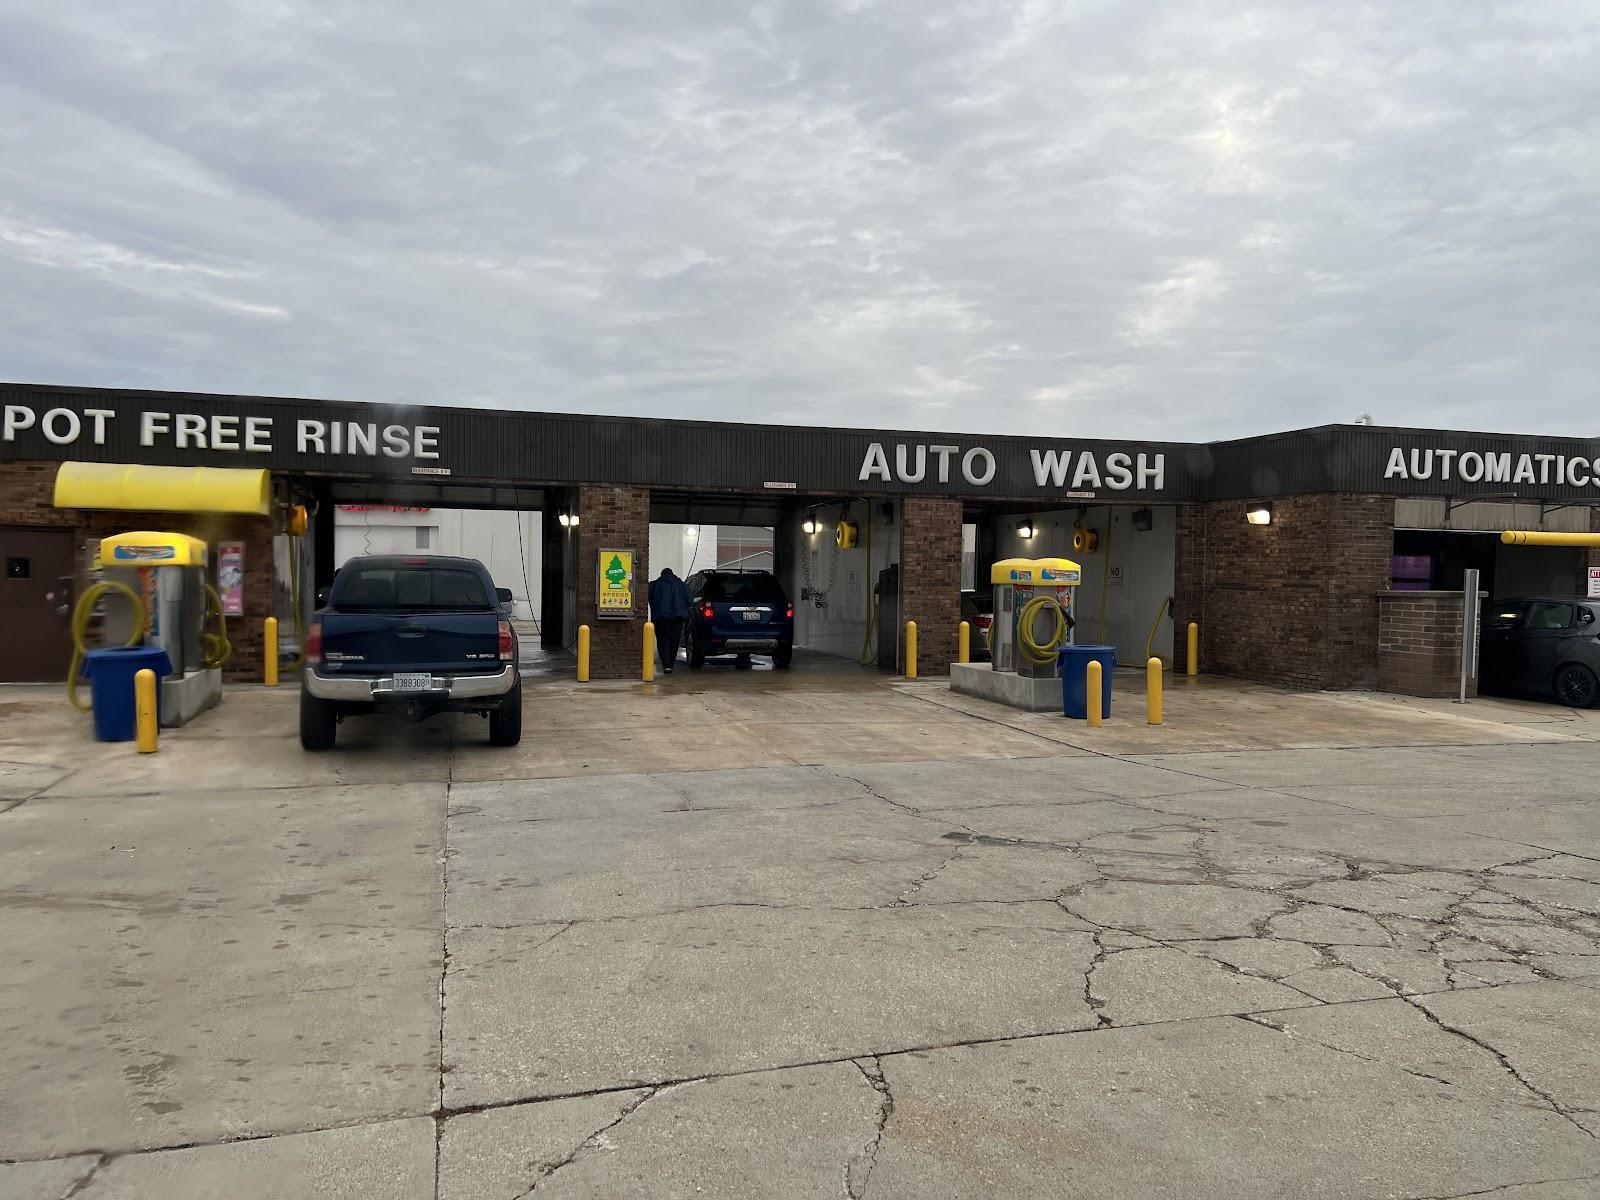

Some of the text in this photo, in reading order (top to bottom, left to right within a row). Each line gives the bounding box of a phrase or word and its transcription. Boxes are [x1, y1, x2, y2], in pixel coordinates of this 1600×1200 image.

[3, 405, 440, 459] POT FREE RINSE
[858, 442, 1165, 491] AUTO WASH
